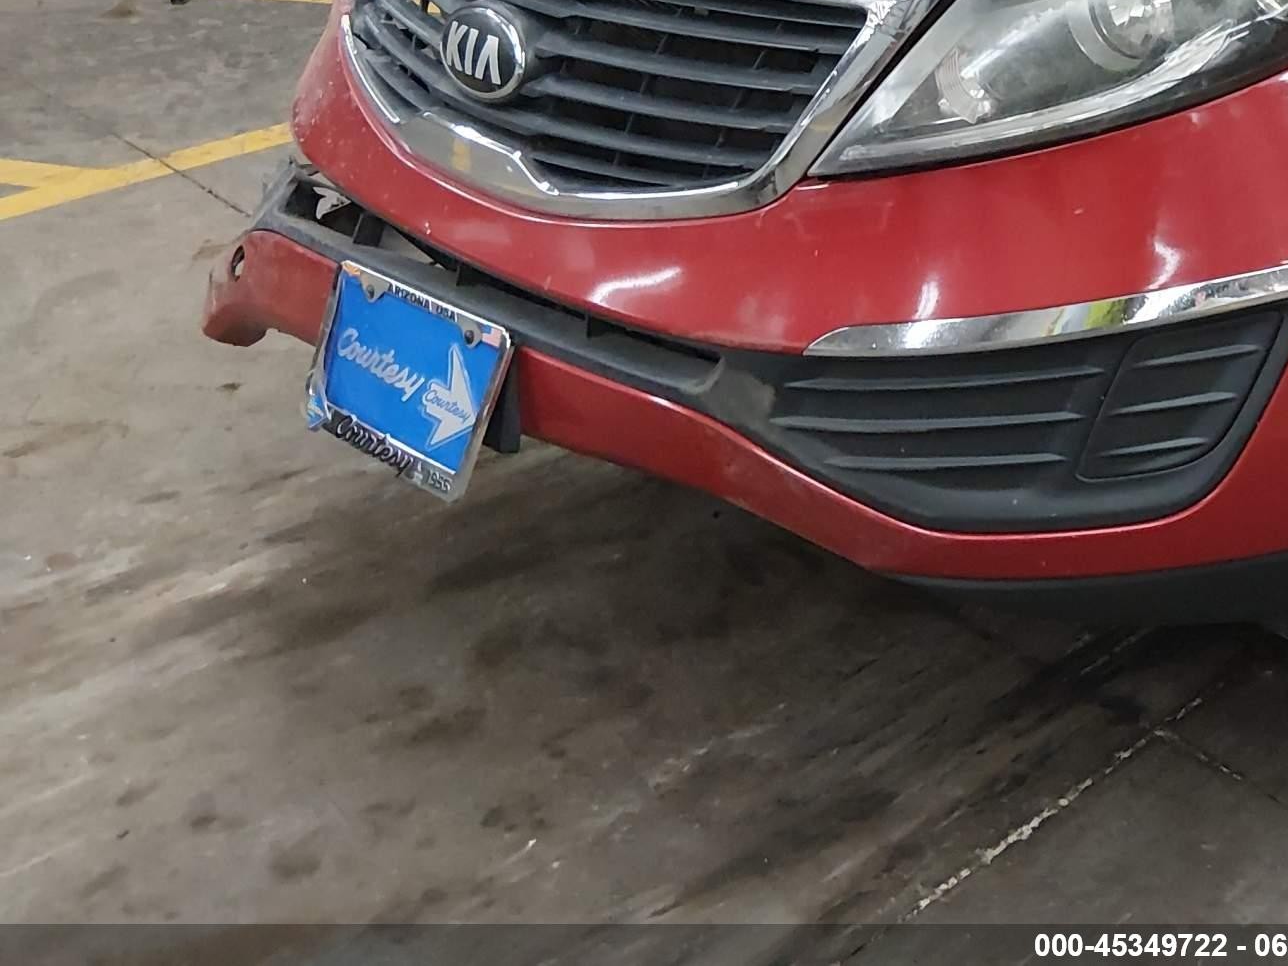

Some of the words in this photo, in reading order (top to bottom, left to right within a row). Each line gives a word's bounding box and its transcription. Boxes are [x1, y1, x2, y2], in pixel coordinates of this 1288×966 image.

[446, 20, 502, 85] KIA
[387, 282, 431, 314] ARIZONA
[435, 304, 457, 323] USA
[337, 328, 425, 401] Courtesy
[425, 389, 472, 421] Courtesy
